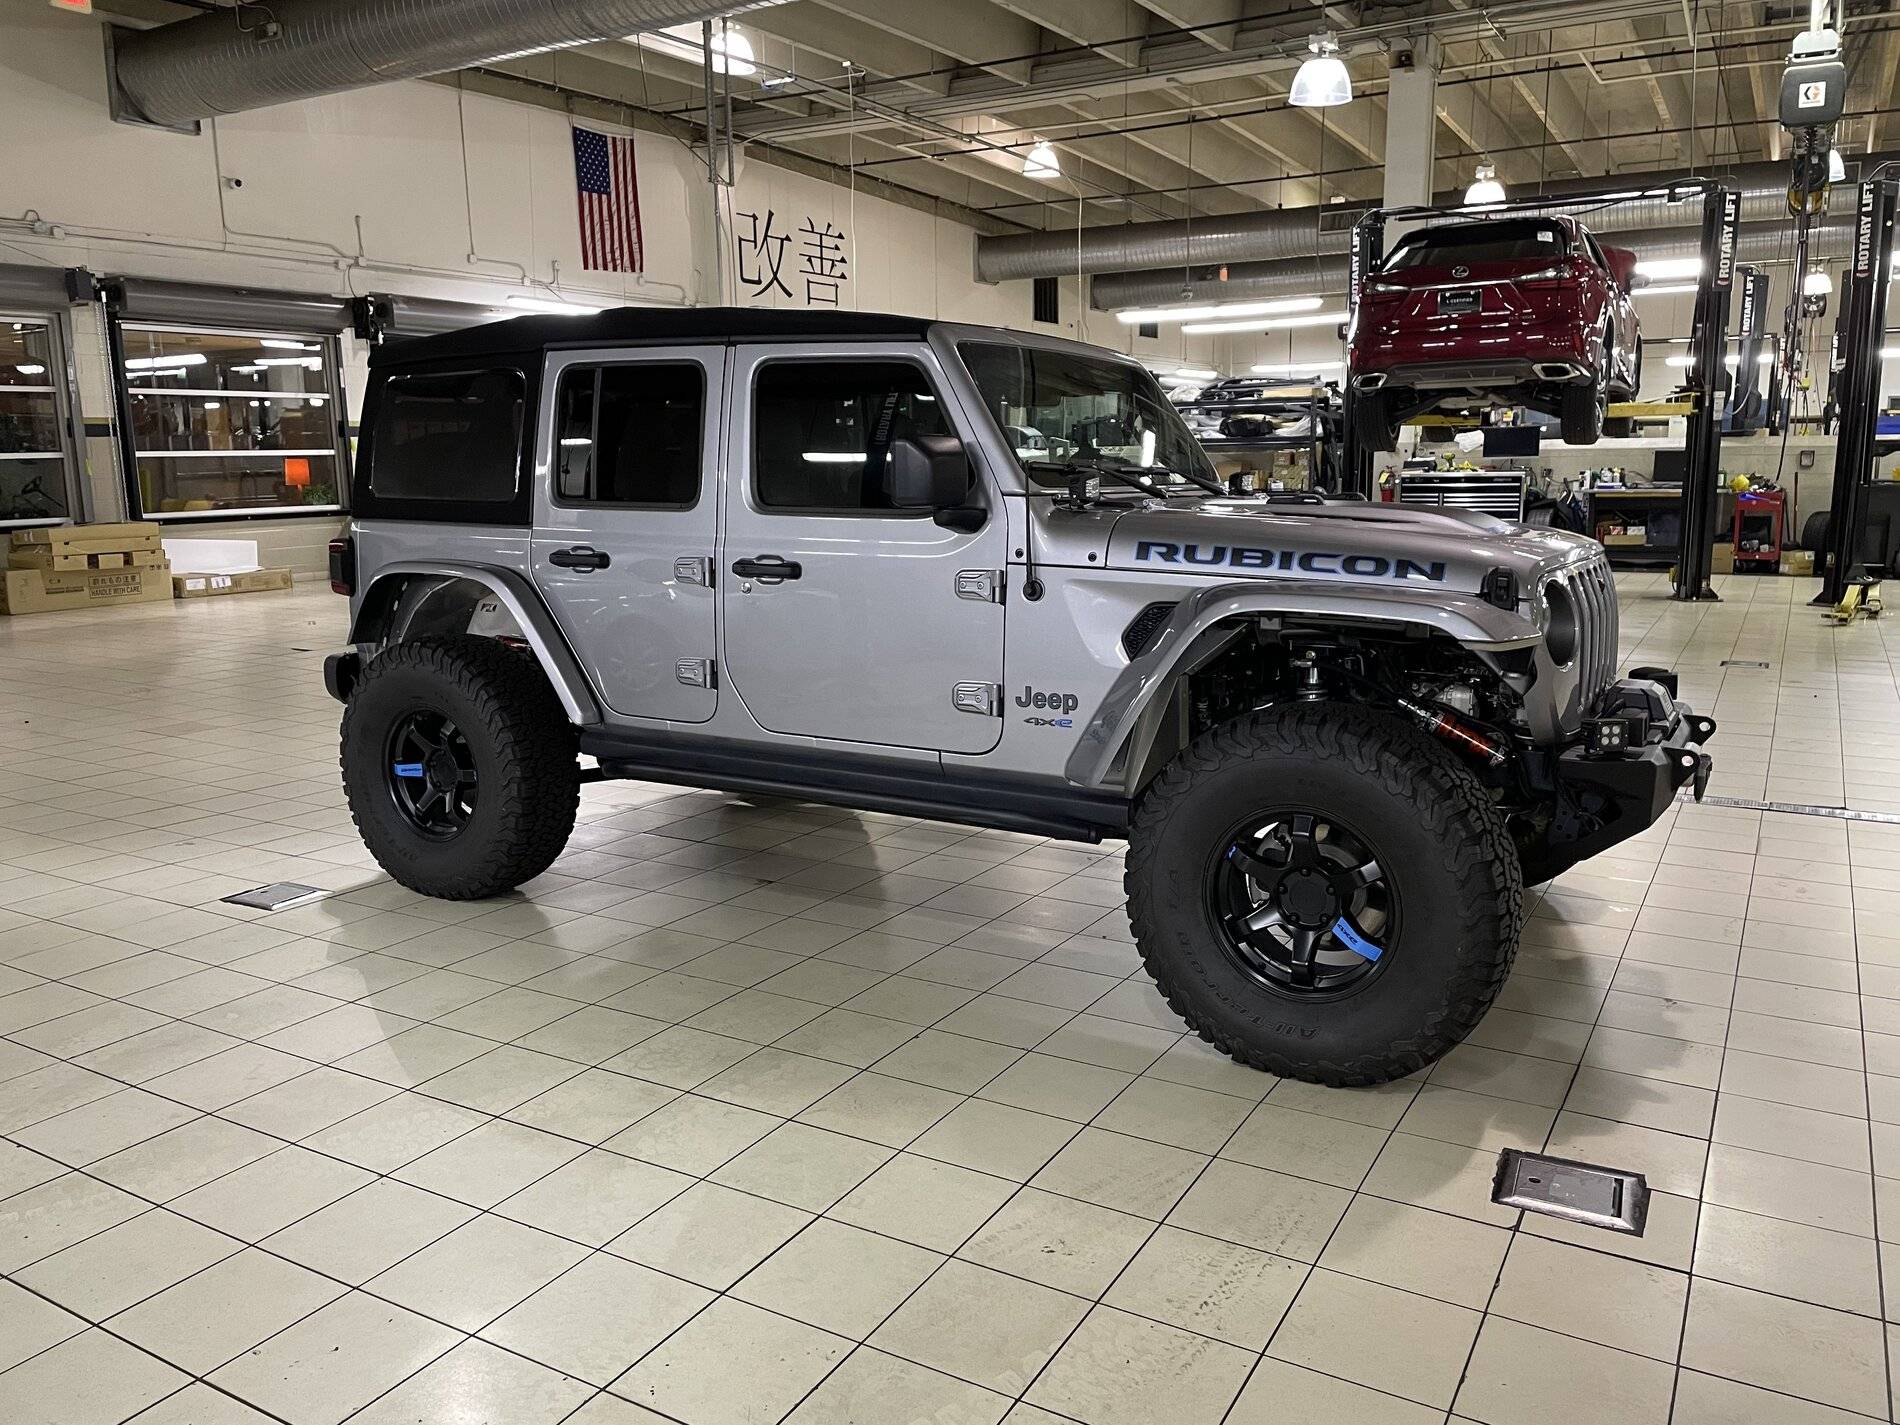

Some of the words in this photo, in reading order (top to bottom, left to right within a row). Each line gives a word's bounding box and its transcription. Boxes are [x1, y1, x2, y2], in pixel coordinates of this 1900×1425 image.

[1724, 193, 1737, 222] LIFT
[1861, 183, 1874, 211] LIFT
[1352, 226, 1360, 252] LIFT
[1718, 225, 1734, 278] ROTARY
[1858, 215, 1872, 271] ROTARY
[736, 209, 848, 306] 改善
[1746, 275, 1754, 295] LIFT
[1743, 296, 1753, 331] ROTARY
[1135, 541, 1448, 582] RUBICON
[91, 588, 112, 597] HANDLE
[113, 587, 126, 595] WITH
[126, 585, 140, 593] CARE
[1015, 686, 1078, 715] Jeep
